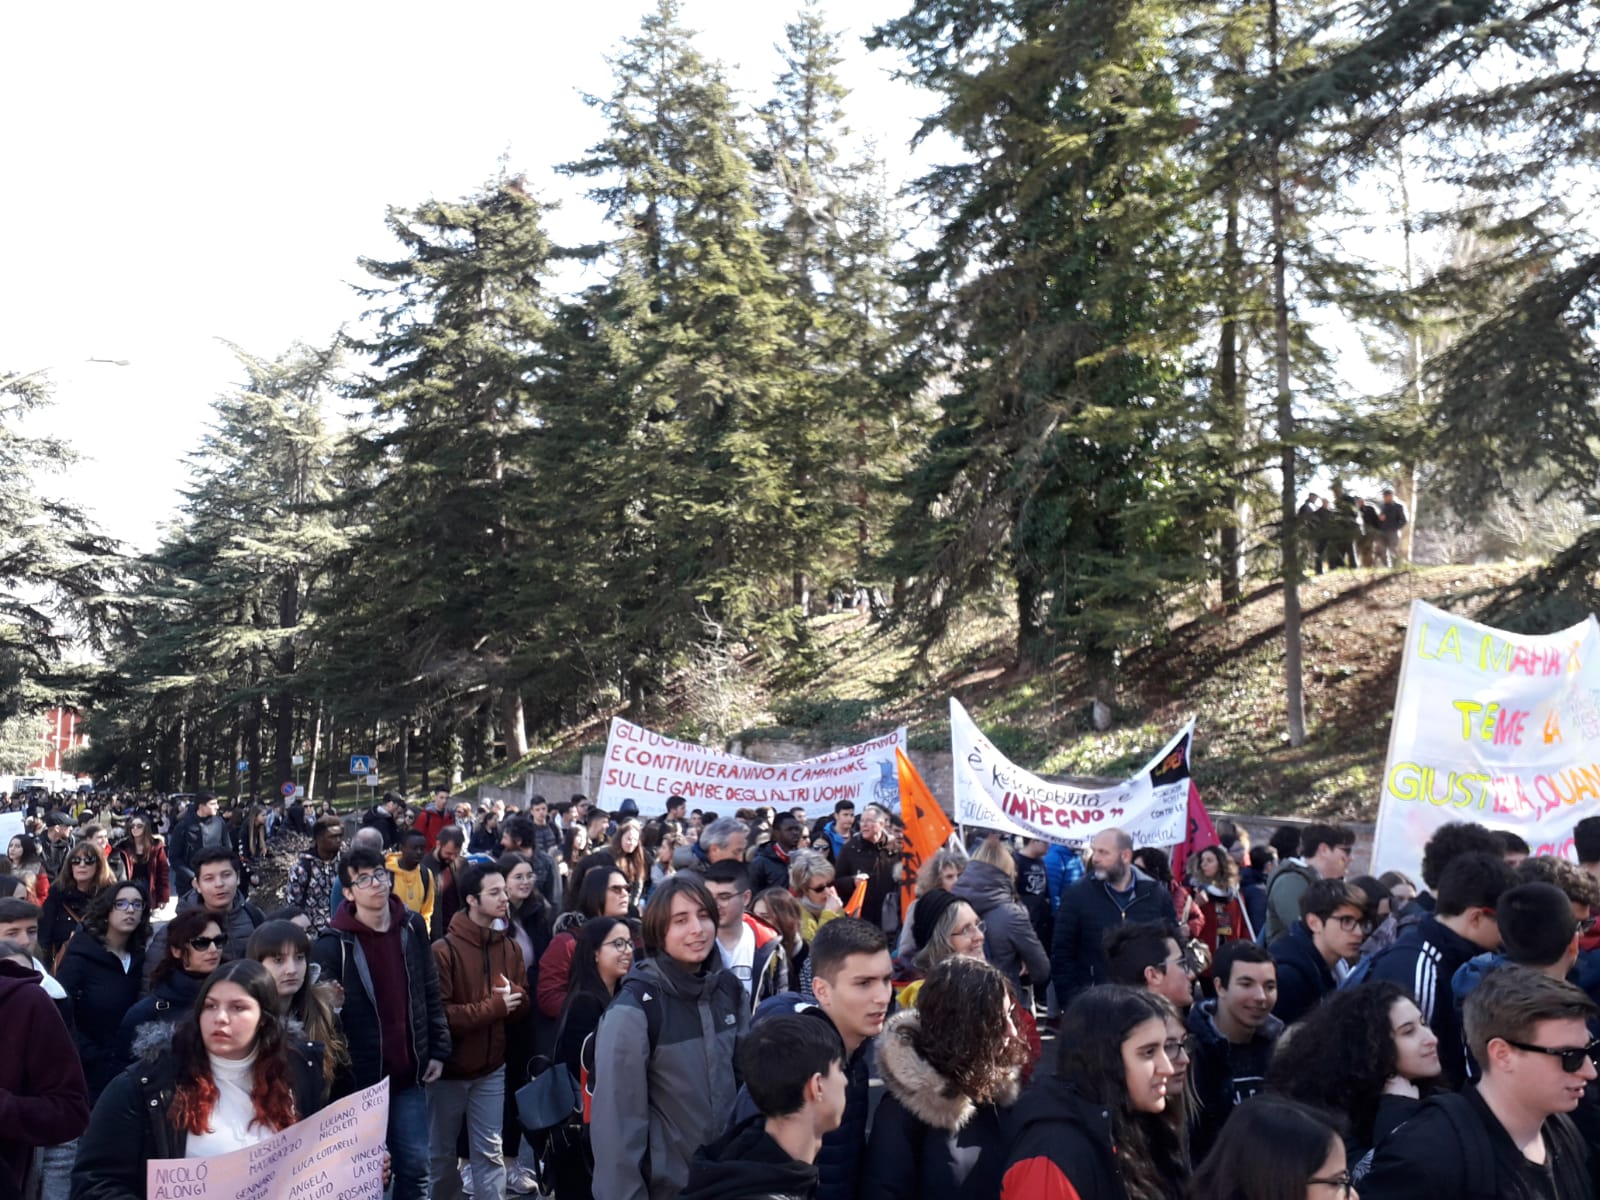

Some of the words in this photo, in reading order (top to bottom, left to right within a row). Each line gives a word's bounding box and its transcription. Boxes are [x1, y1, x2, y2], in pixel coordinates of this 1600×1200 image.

[1418, 622, 1462, 662] LA
[616, 723, 645, 743] GLI
[1452, 698, 1530, 746] TEME
[611, 745, 623, 761] E
[624, 746, 775, 780] CONTINUERANNO
[776, 769, 787, 781] A
[606, 768, 668, 795] SULLE
[669, 780, 723, 801] GAMBE
[320, 1107, 356, 1132] LUCIANO
[292, 1156, 314, 1176] LUCA
[155, 1183, 207, 1200] ALONGI
[288, 1171, 328, 1200] ANGELA
[336, 1177, 380, 1200] ROSARIO
